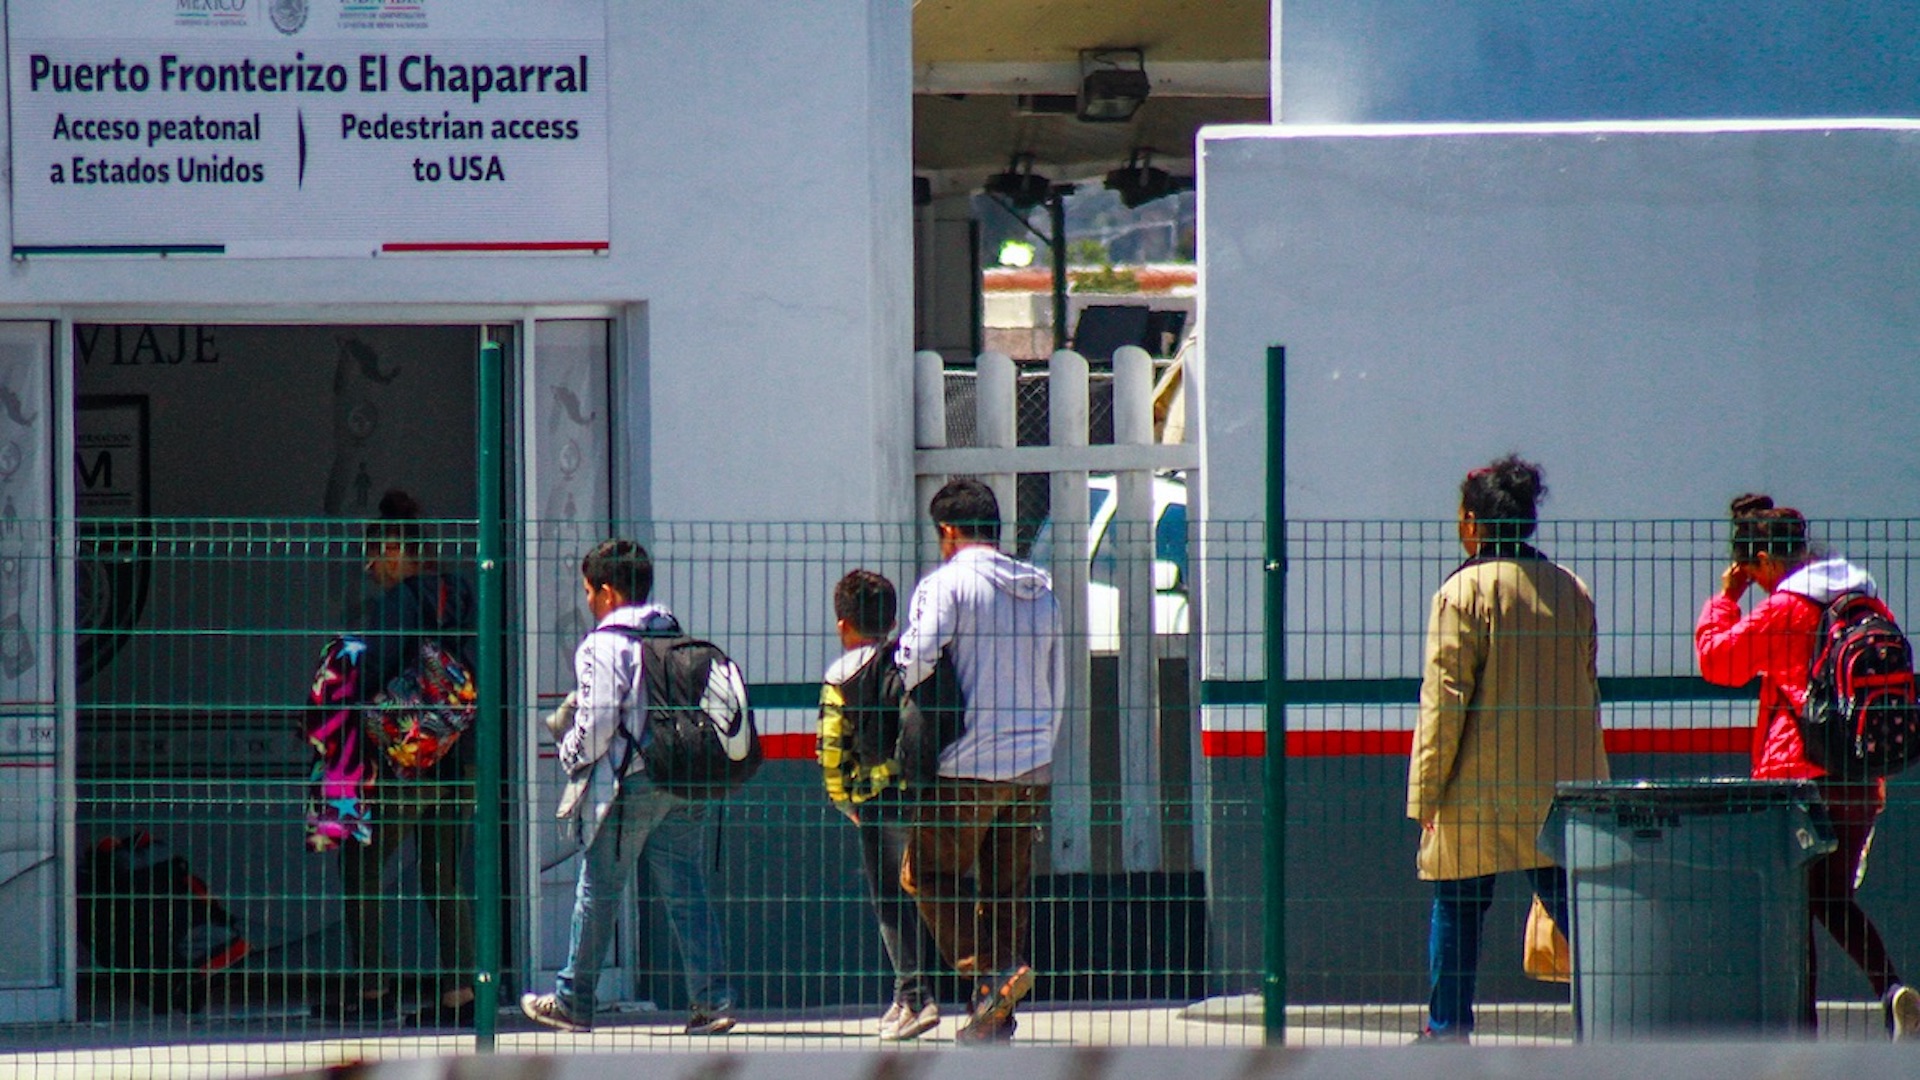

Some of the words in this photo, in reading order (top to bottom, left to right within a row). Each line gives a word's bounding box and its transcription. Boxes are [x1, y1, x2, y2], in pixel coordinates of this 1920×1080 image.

[30, 54, 150, 93] Puerto
[160, 51, 348, 93] Fronterizo
[359, 54, 388, 93] El
[399, 54, 588, 104] Chaparral
[52, 113, 140, 142] Acceso
[147, 113, 261, 147] peatonal
[341, 111, 484, 140] Pedestrian
[491, 118, 580, 140] access
[50, 162, 65, 184] a
[72, 155, 170, 184] Estados
[177, 154, 265, 184] Unidos
[413, 157, 441, 183] to
[448, 154, 506, 183] USA
[75, 325, 219, 366] VIAJE
